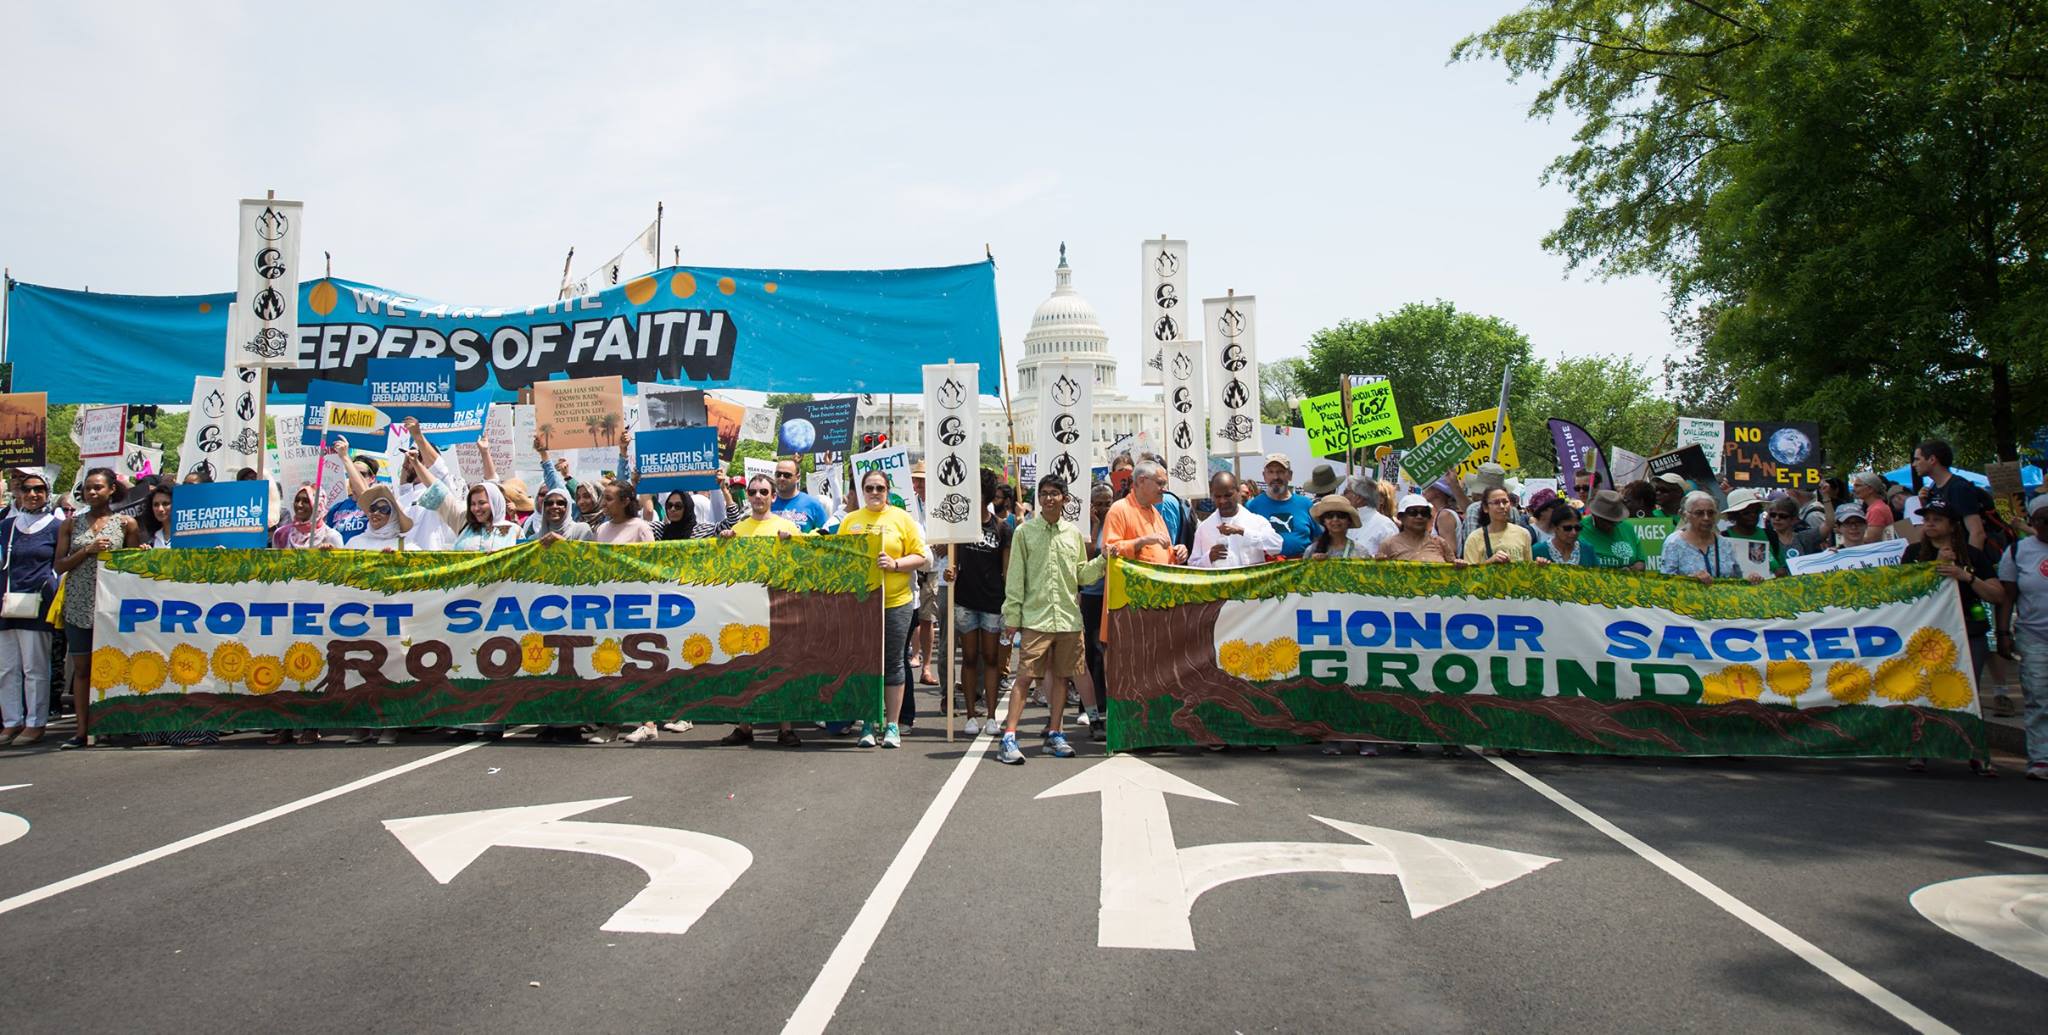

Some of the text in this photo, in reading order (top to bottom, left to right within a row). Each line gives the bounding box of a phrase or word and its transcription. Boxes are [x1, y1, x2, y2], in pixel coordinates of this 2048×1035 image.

[353, 288, 417, 317] WE
[297, 311, 724, 371] EEPERS OF FAITH
[372, 381, 437, 394] THE EARTH IS
[372, 393, 450, 402] GREEN AND BEAUTIFUL
[332, 408, 372, 428] Muslim
[4, 438, 25, 446] walk
[1735, 426, 1762, 443] NO
[1008, 444, 1029, 455] Hndu
[1403, 425, 1454, 468] CLIMATE
[640, 451, 703, 466] THE EARTH IS
[640, 461, 715, 474] GREEN AND BEAUTIFUL
[855, 452, 905, 475] PROTECT
[1413, 436, 1463, 479] JUSTICE
[1725, 442, 1802, 488] PLANET
[1806, 468, 1820, 484] B
[176, 505, 248, 522] THE EARTH IS
[176, 517, 263, 531] GREEN AND BEAUTIFUL
[118, 594, 696, 637] PROTECT SACRED
[1296, 609, 1903, 661] HONOR SACRED
[318, 633, 670, 695] ROOTS
[1299, 650, 1705, 703] GROUND
